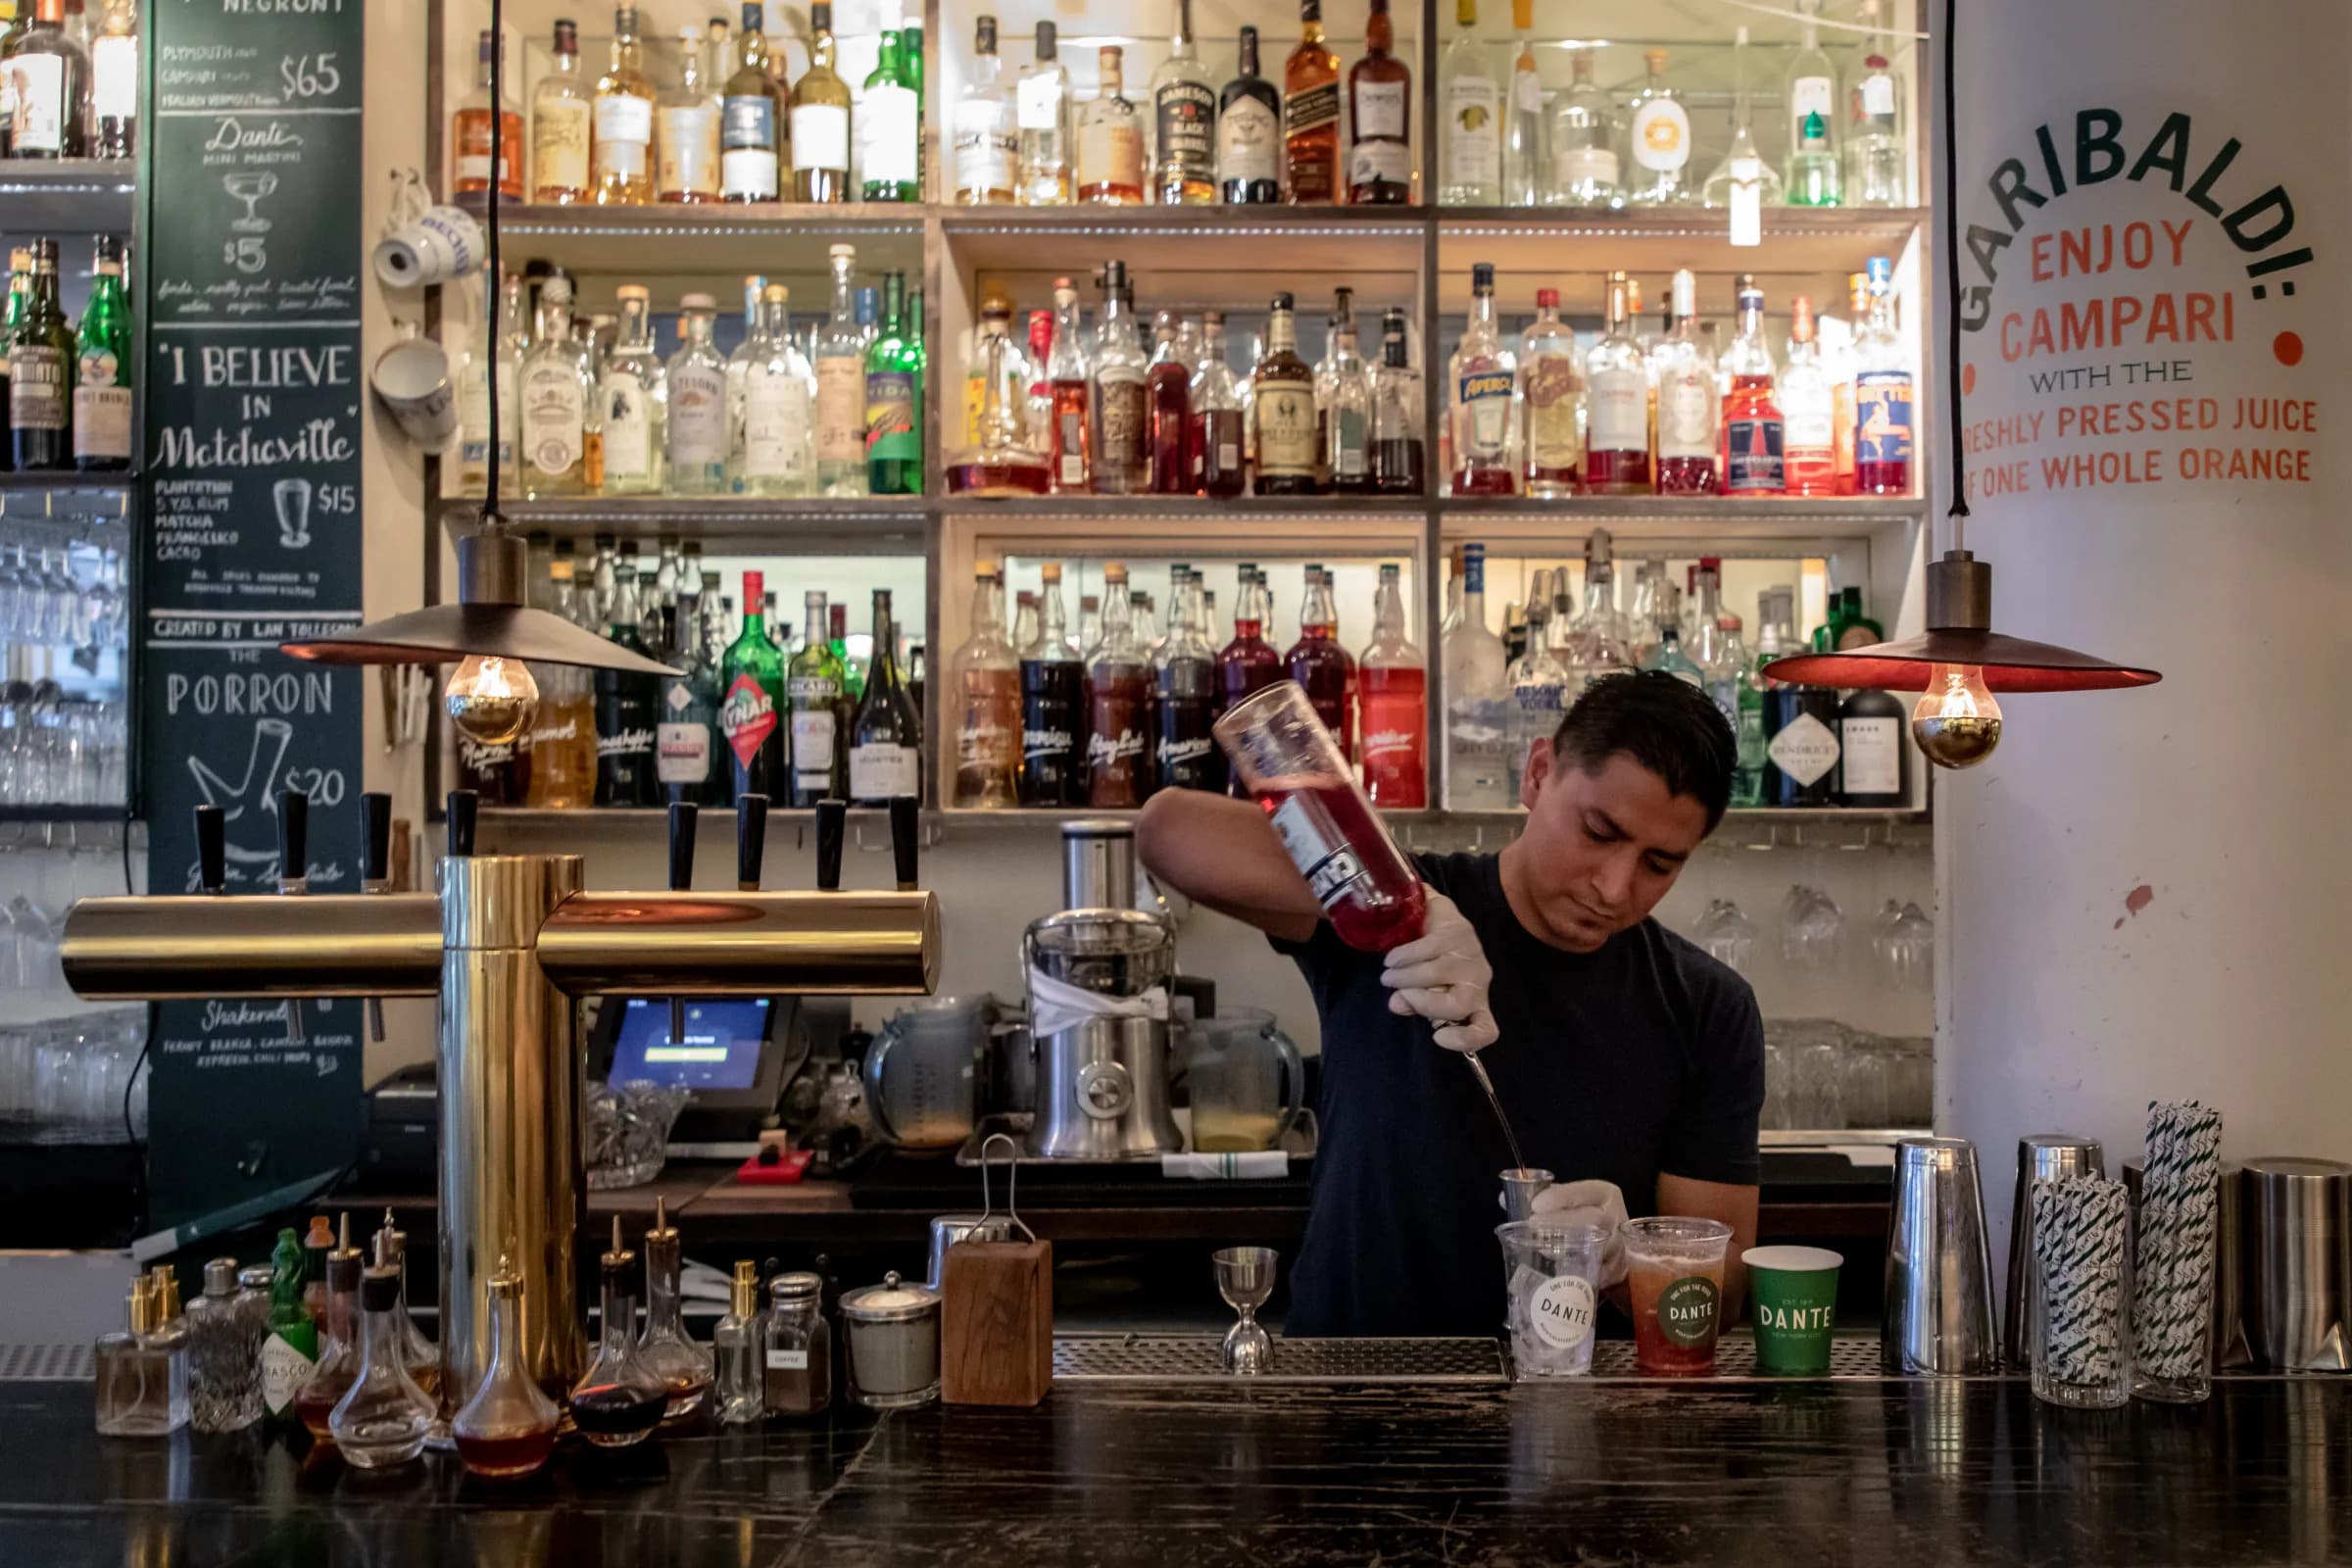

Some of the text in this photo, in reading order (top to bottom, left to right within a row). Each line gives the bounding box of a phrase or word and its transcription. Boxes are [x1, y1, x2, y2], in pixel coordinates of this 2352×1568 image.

[223, 0, 343, 13] NEGRONI
[280, 52, 340, 101] $65
[205, 117, 304, 151] Dante
[224, 237, 267, 273] $5
[2031, 219, 2194, 283] ENJOY
[2000, 291, 2233, 363] CAMPARI
[202, 346, 352, 387] BELIEVE
[2031, 360, 2193, 394] WITH THE
[1464, 376, 1510, 398] APEROL
[243, 396, 270, 419] IN
[1962, 398, 2318, 456] RESHLY PRESSED JUICE
[1984, 461, 2031, 494] ONE
[2040, 450, 2163, 488] WHOLE
[2178, 448, 2312, 482] ORANGE
[197, 497, 229, 512] RUM
[318, 483, 356, 514] $15
[155, 514, 214, 527] MATCHA
[157, 547, 201, 561] CACAO
[154, 620, 216, 637] CREATED
[222, 621, 242, 639] BY
[229, 650, 261, 663] THE
[168, 670, 332, 715] PORRON
[722, 694, 772, 738] CYNAR
[1679, 1285, 1690, 1294] FOR
[1542, 1298, 1589, 1326] DANTE
[1670, 1301, 1712, 1320] DANTE
[1760, 1304, 1832, 1330] DANTE
